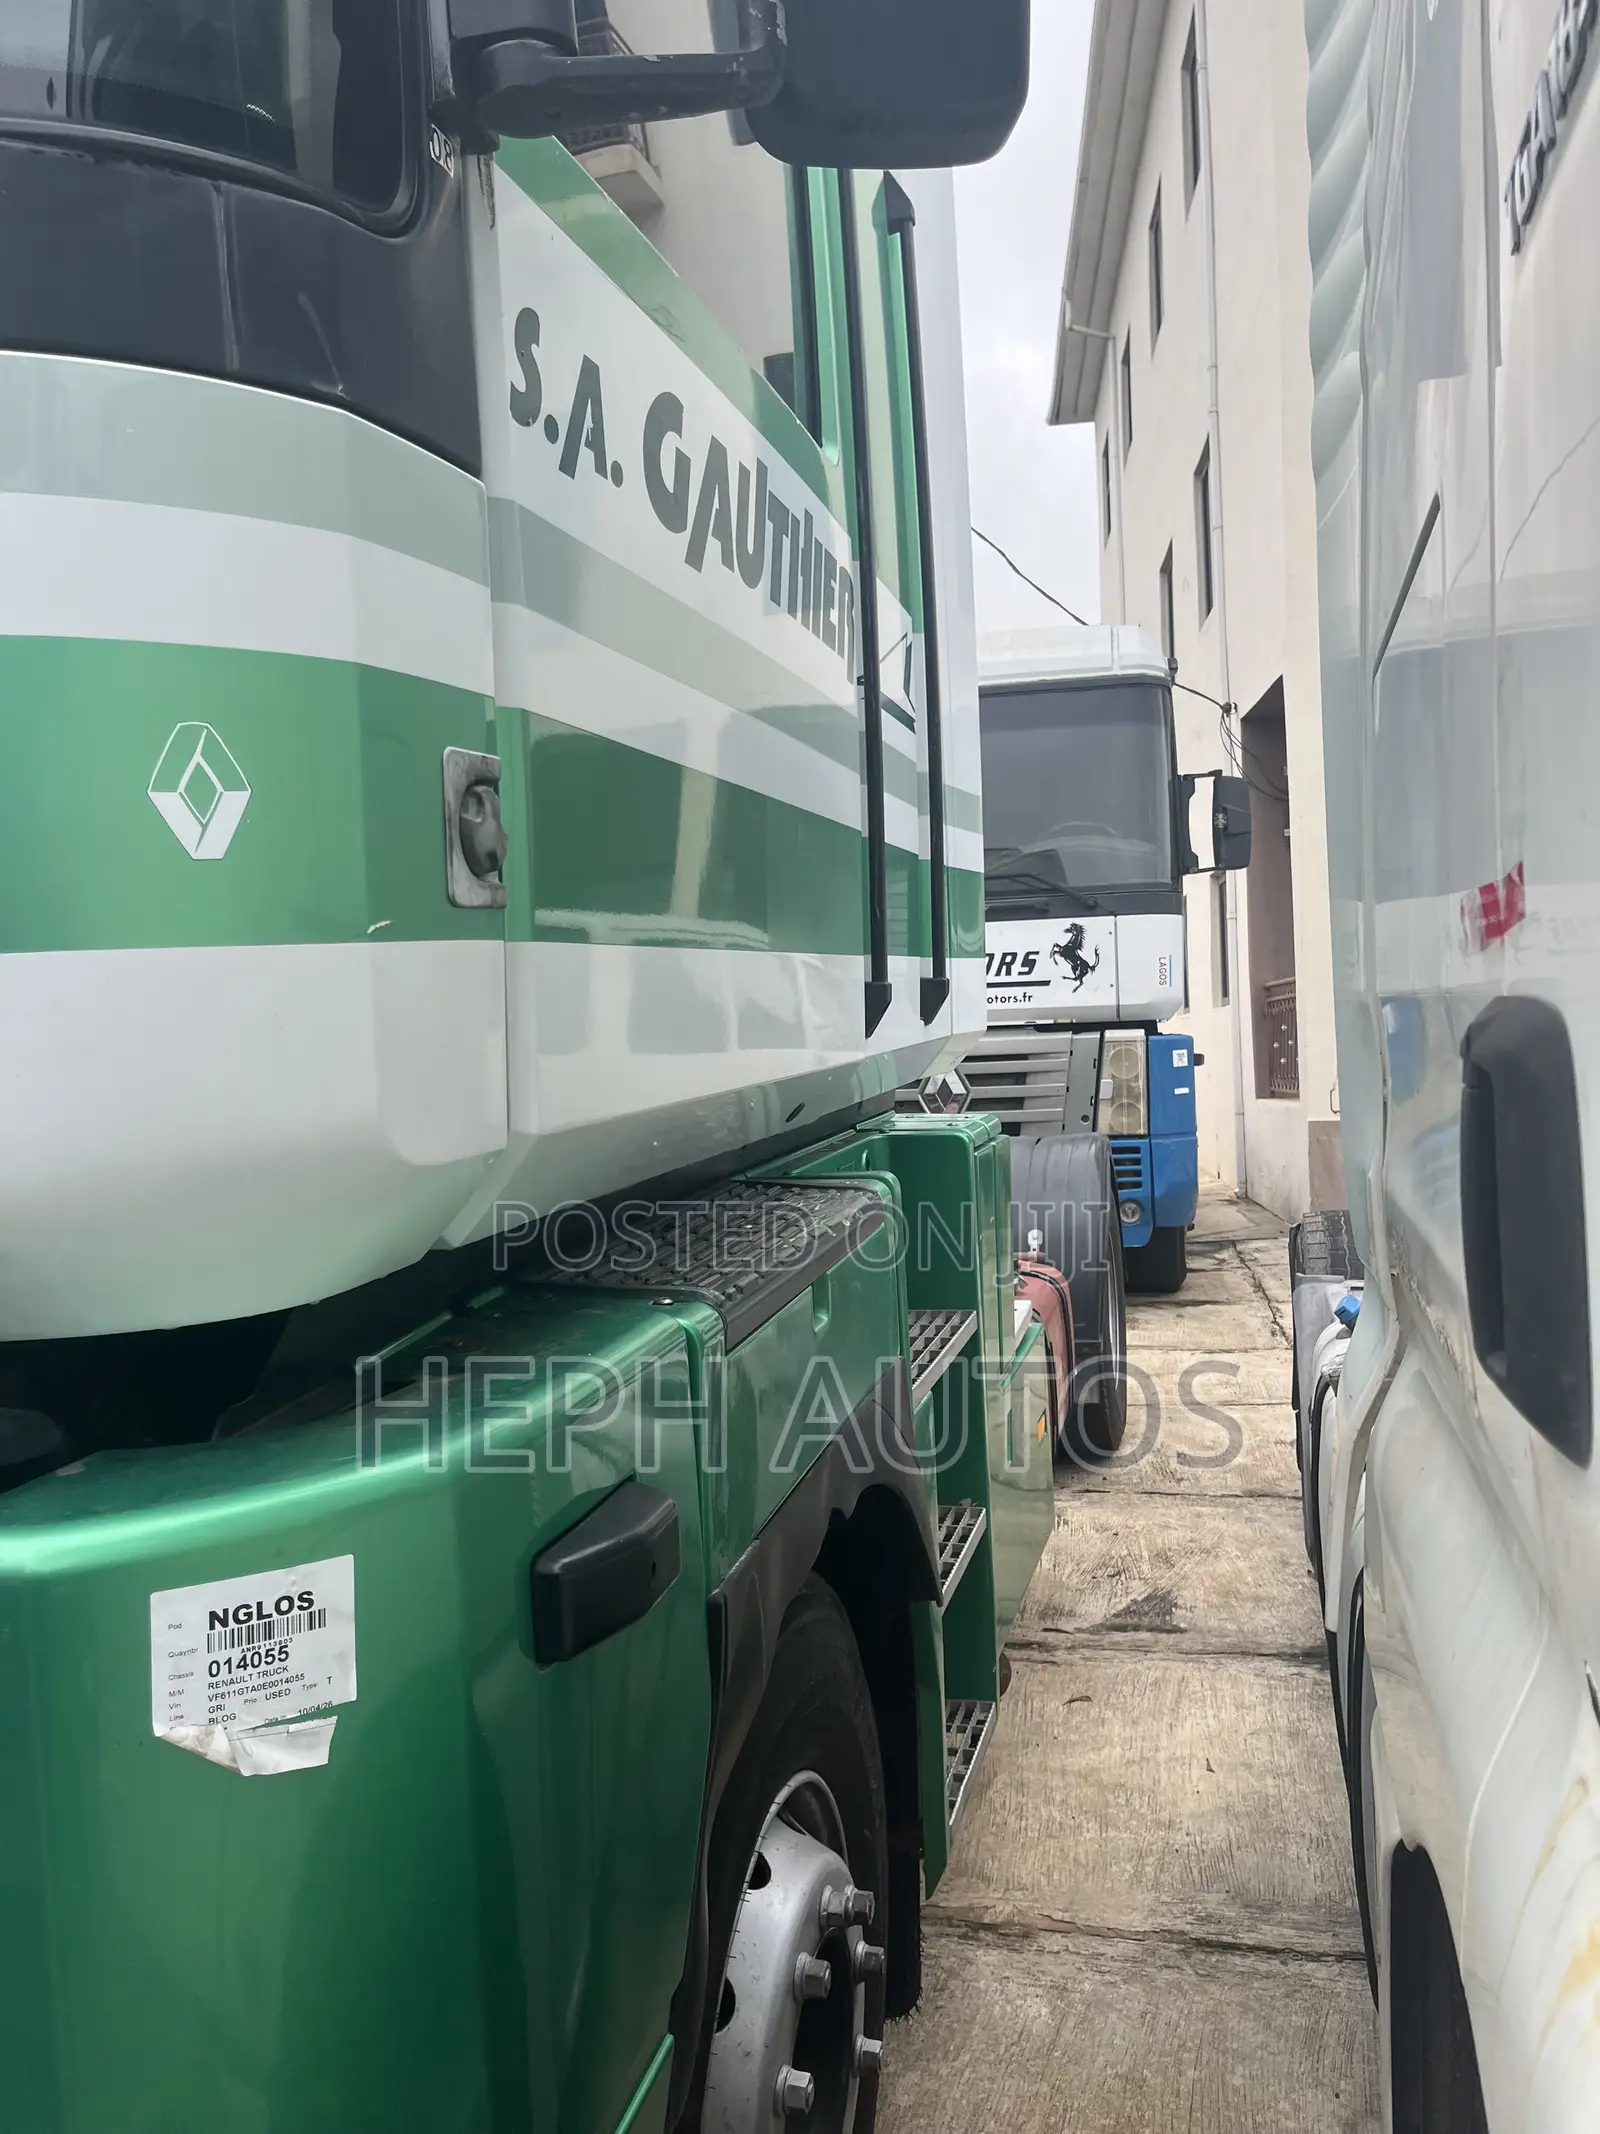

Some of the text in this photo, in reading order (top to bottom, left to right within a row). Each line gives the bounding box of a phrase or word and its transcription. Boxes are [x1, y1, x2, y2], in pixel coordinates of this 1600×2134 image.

[510, 307, 855, 686] S.A. GAUTHIER
[1158, 956, 1167, 986] LAGOS
[987, 992, 1033, 1004] otors.fr
[208, 1591, 315, 1631] NGLOS
[207, 1674, 254, 1690] RENAULT
[256, 1665, 290, 1680] TRUCK
[208, 1645, 290, 1678] 014055
[208, 1704, 226, 1714] GRI
[265, 1689, 291, 1701] USED
[326, 1676, 333, 1685] T
